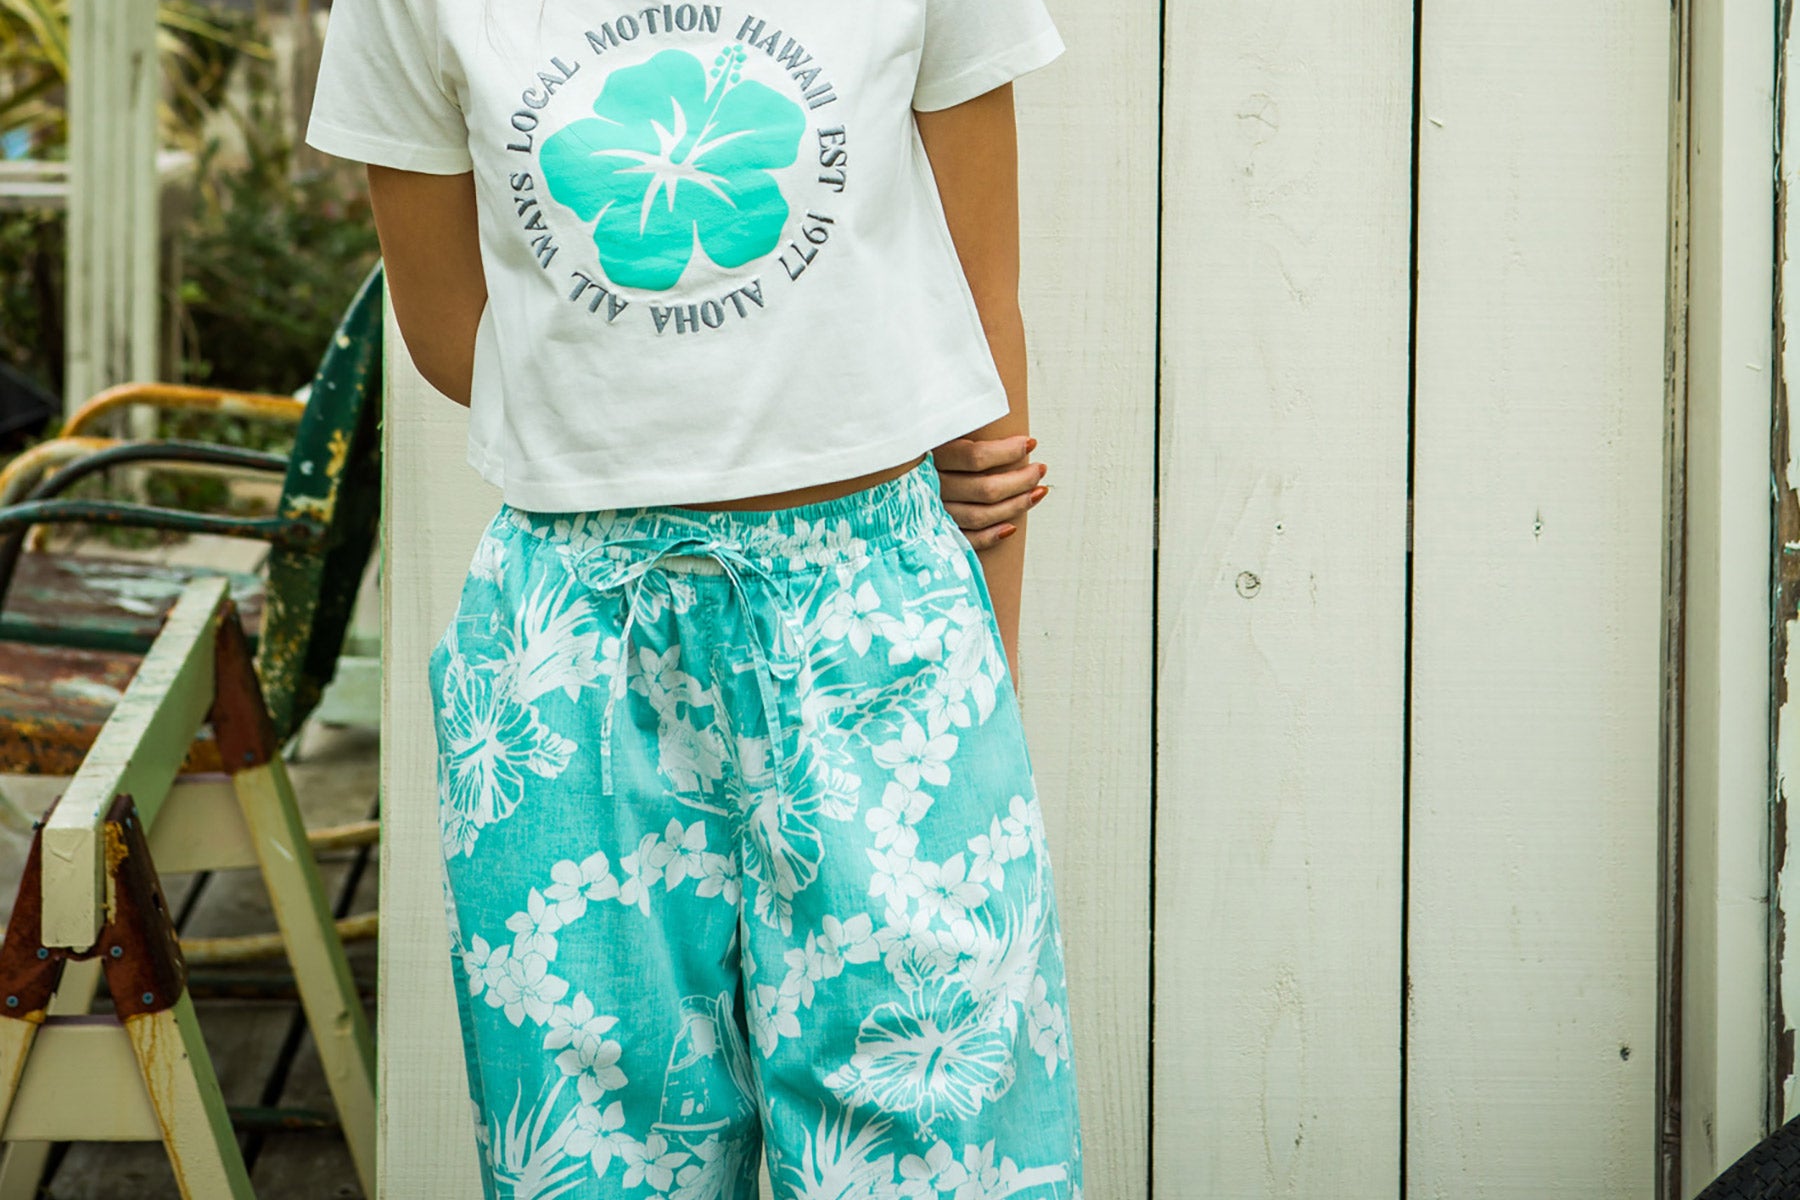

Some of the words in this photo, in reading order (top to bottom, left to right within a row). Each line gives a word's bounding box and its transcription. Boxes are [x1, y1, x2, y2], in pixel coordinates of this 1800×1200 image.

[584, 3, 722, 55] MOTION
[735, 14, 838, 110] HAWAII
[506, 56, 581, 155] LOCAL
[817, 124, 847, 193] EST
[510, 171, 559, 269] WAYS
[779, 209, 835, 282] 1977
[568, 270, 629, 322] ALL
[650, 278, 765, 334] ALOHA
